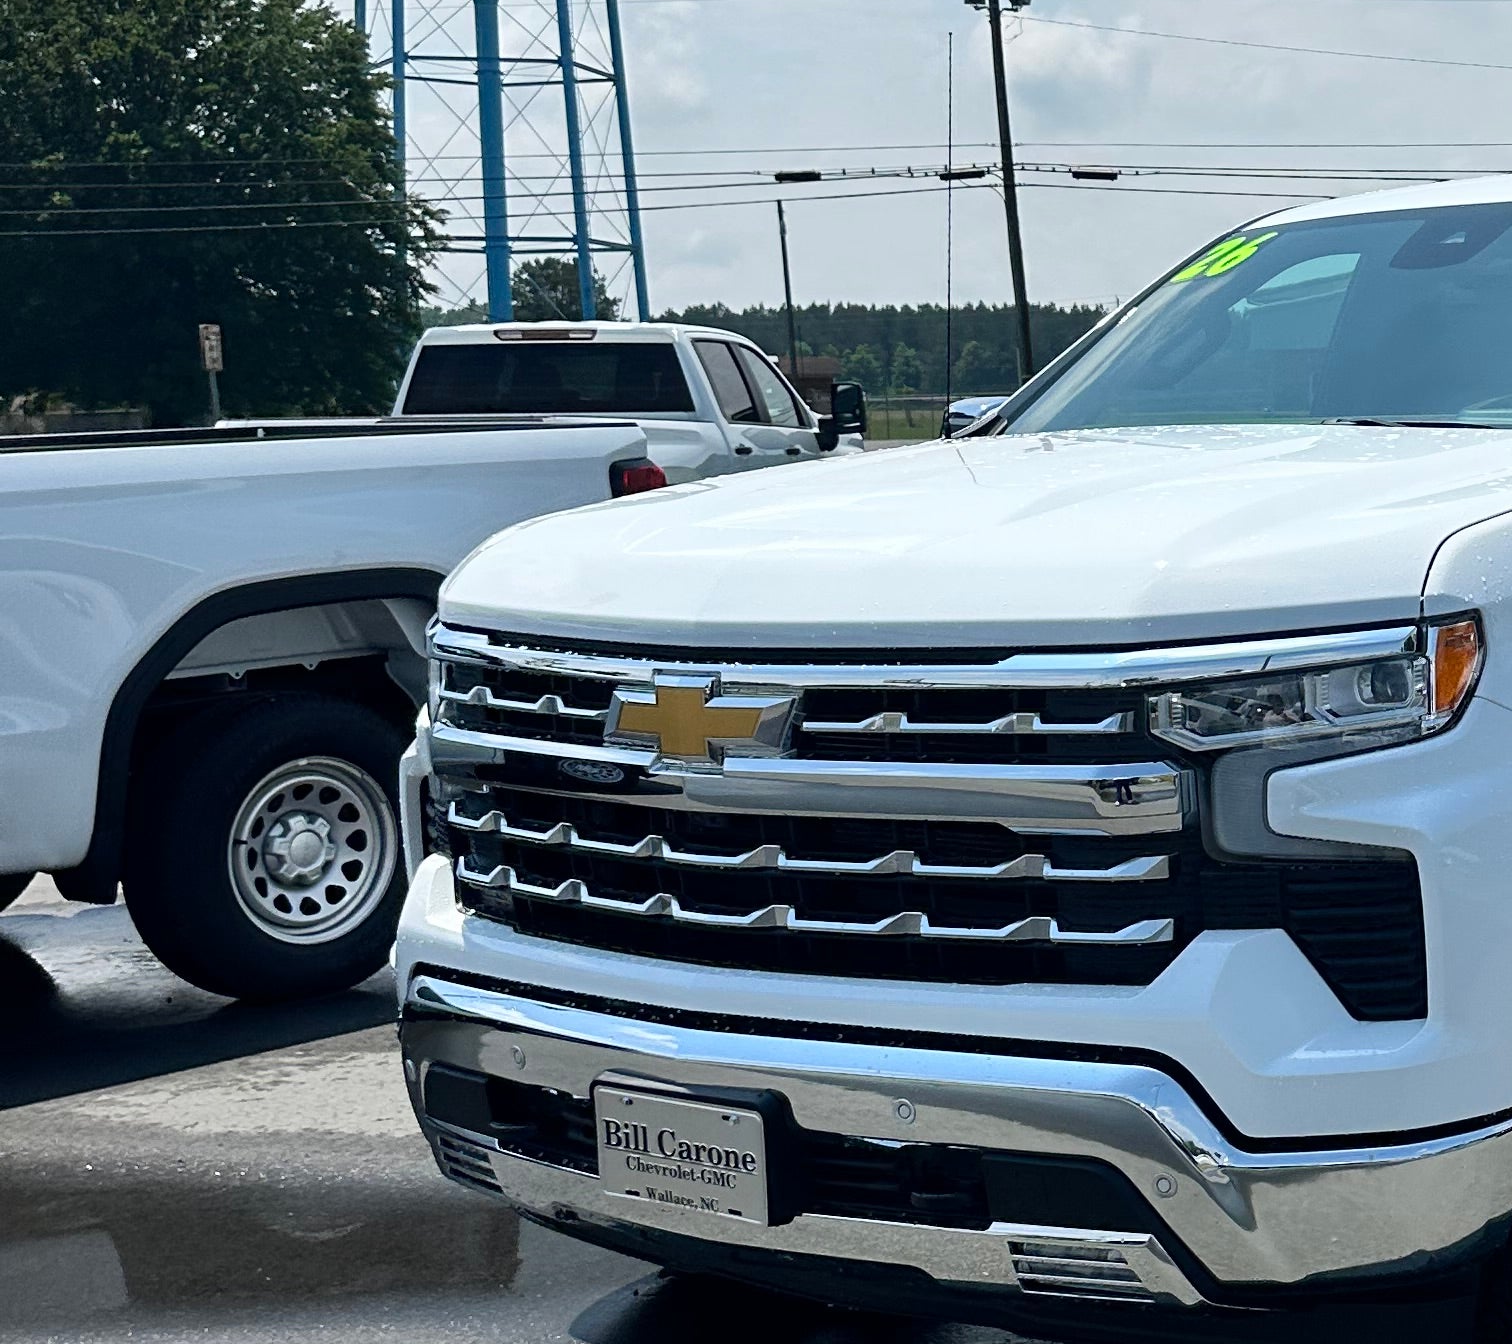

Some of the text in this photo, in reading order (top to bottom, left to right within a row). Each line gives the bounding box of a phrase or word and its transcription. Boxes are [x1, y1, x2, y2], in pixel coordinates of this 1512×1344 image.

[602, 1118, 757, 1172] Bill Carone
[626, 1155, 737, 1189] Chevrolet-GMC
[645, 1185, 720, 1212] Wallace, NC
